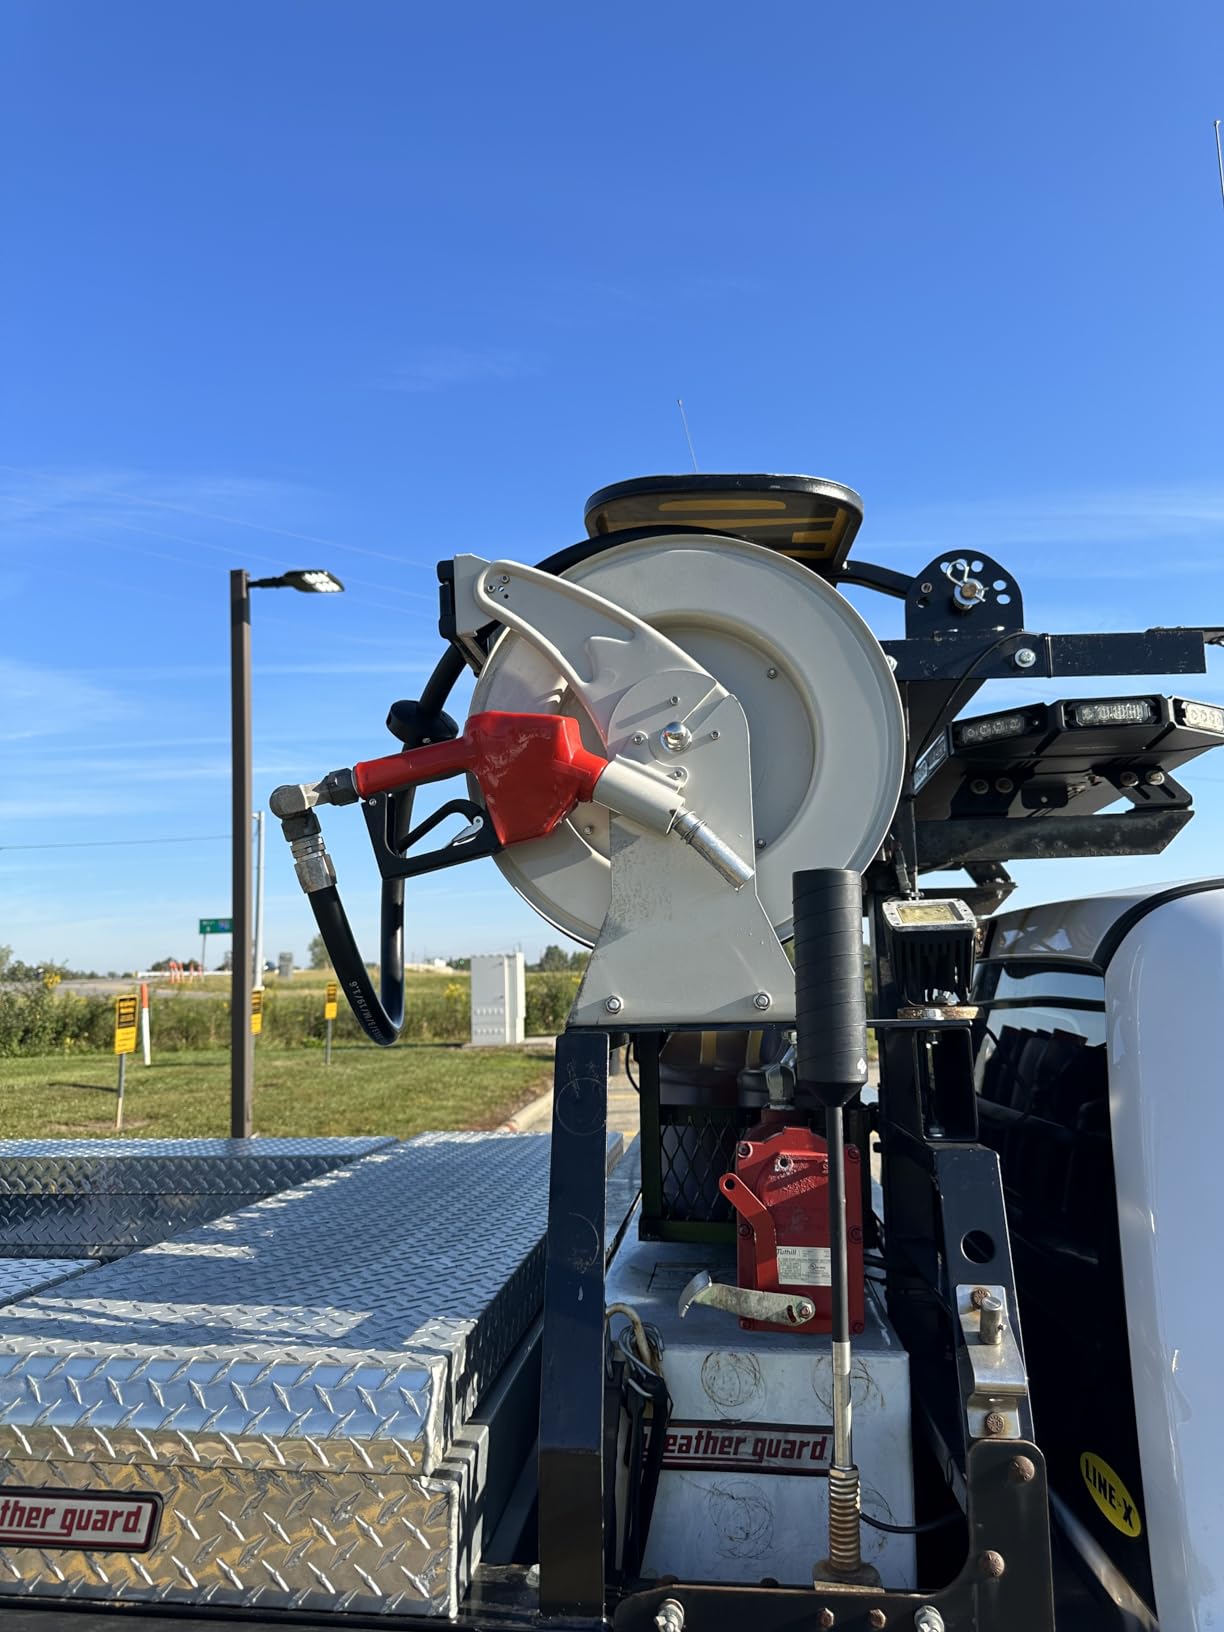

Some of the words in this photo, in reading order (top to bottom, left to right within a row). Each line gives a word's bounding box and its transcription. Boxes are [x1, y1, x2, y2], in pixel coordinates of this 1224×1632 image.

[753, 1435, 828, 1463] guard
[1085, 1456, 1135, 1530] LINE-X
[59, 1505, 143, 1537] guard
